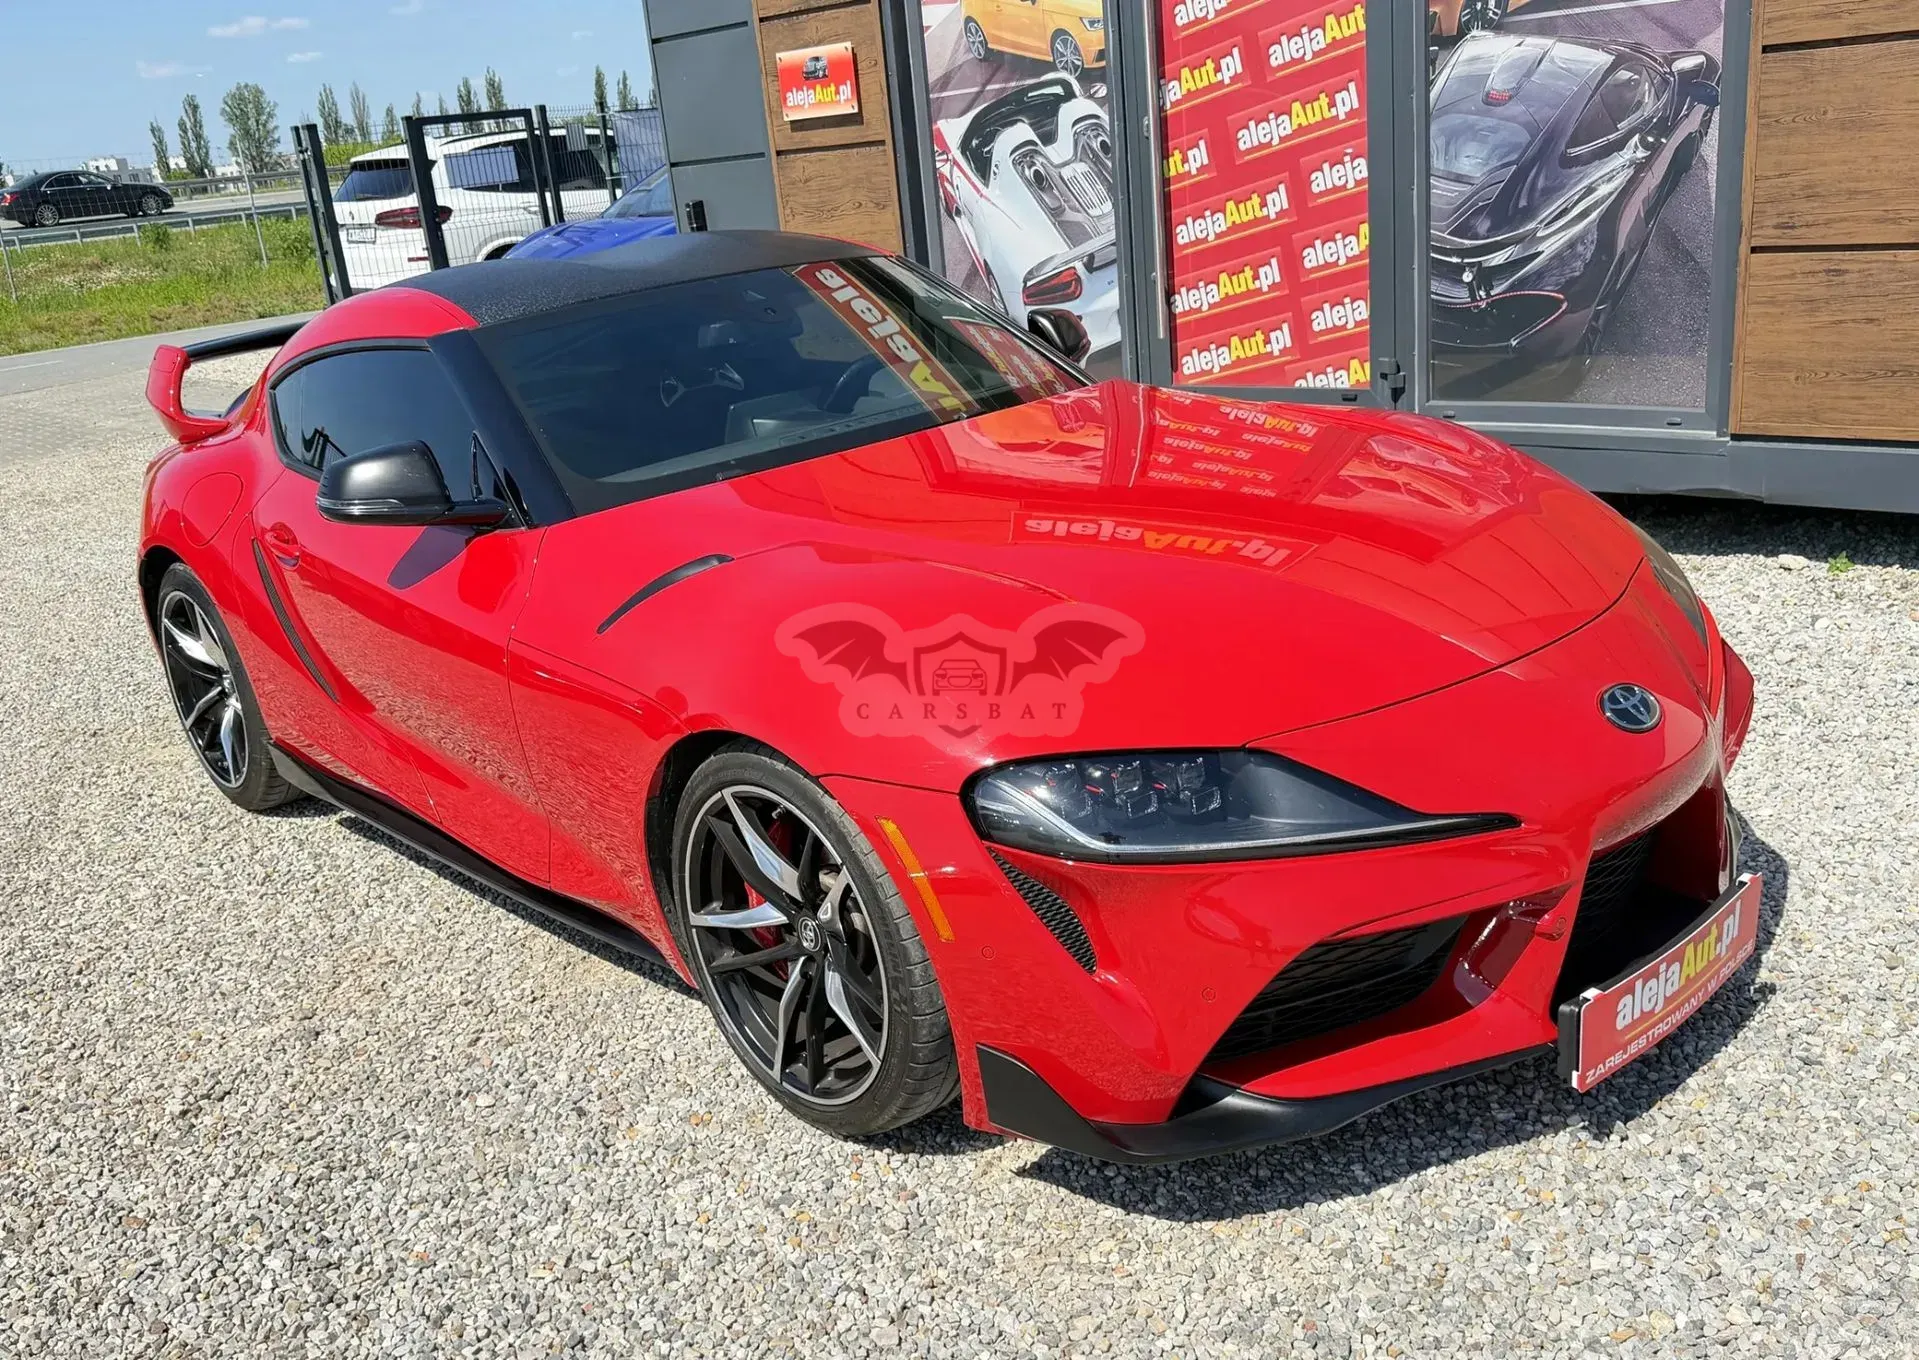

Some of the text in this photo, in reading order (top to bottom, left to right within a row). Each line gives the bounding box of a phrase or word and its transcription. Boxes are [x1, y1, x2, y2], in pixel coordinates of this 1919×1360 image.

[1268, 3, 1366, 68] alejaAut
[785, 80, 852, 109] alejaAut.pl
[1159, 46, 1243, 110] jaAut.pl
[1237, 81, 1359, 151] alejaAut.pl
[1310, 154, 1368, 194] aleja
[1175, 183, 1289, 245] alejaAut.pl
[1170, 257, 1281, 314] alejaAut.pl
[1311, 296, 1368, 332] aleja
[1181, 322, 1292, 375] alejaAut.pl
[1616, 899, 1741, 1030] alejaAut.pl
[1585, 988, 1705, 1084] ZAREJESTROWANY
[1707, 975, 1718, 992] W
